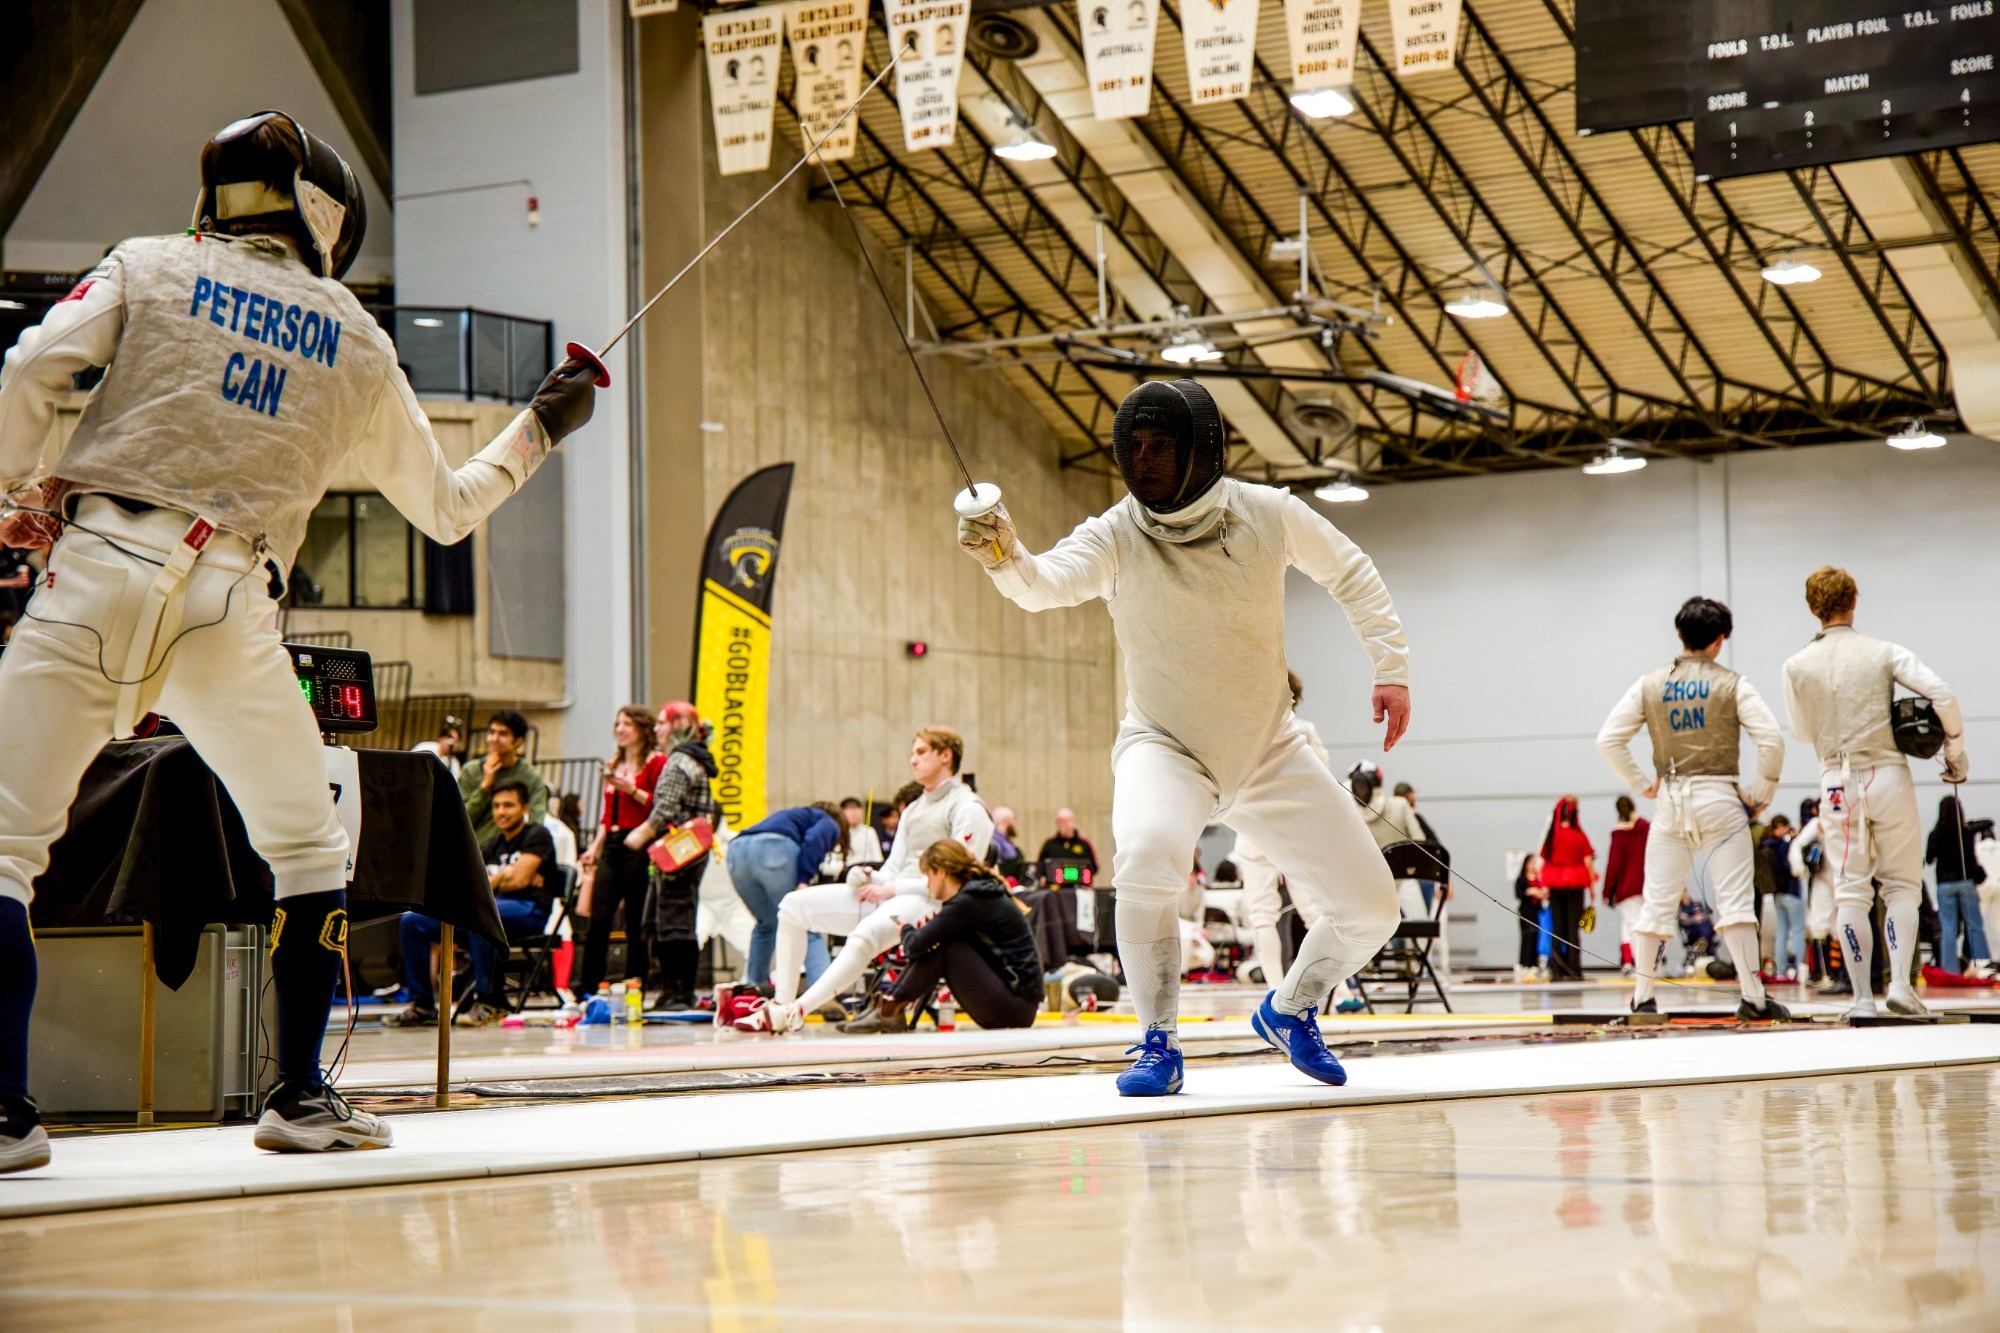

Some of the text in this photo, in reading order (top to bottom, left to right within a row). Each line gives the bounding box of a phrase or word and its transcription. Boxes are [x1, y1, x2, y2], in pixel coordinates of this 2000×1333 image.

[1951, 1, 1994, 22] FOULS
[1807, 17, 1890, 44] PLAYER FOUL
[1707, 39, 1748, 60] FOULS
[1760, 33, 1795, 51] T.O.L.
[1951, 54, 1994, 76] SCORE
[1824, 73, 1869, 94] MATCH
[1707, 92, 1748, 112] SCORE
[1960, 88, 1971, 103] 4
[1881, 99, 1892, 115] 3
[1804, 111, 1815, 127] 2
[1728, 122, 1738, 138] 1
[190, 275, 341, 368] PETERSON
[221, 351, 287, 417] CAN
[1662, 680, 1710, 703] ZHOU
[719, 627, 752, 825] #GOBLACKGOGOLD
[1670, 707, 1705, 731] CAN
